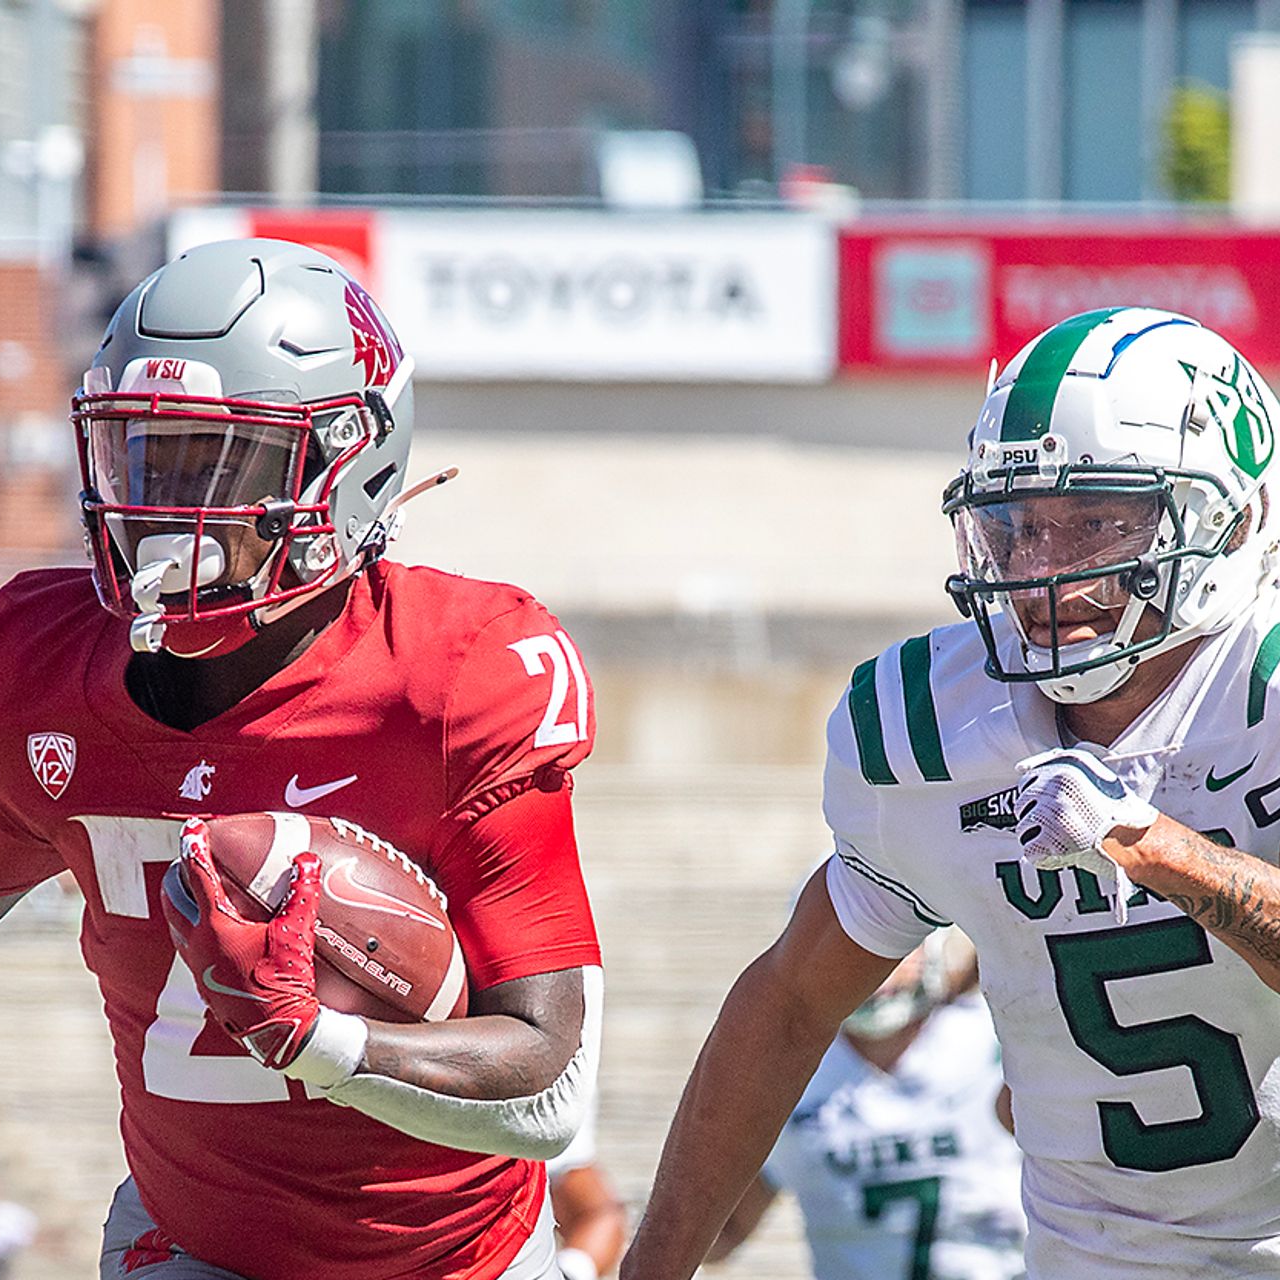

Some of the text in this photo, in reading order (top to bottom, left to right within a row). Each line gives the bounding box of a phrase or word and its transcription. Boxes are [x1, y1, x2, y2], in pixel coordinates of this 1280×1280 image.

[420, 250, 766, 328] TOYOTA
[146, 359, 186, 381] WSU
[1002, 449, 1037, 465] PSU
[506, 630, 588, 748] 21
[30, 735, 73, 774] PAC
[41, 762, 64, 786] 12
[364, 960, 413, 998] ELITE
[1045, 916, 1261, 1173] 5
